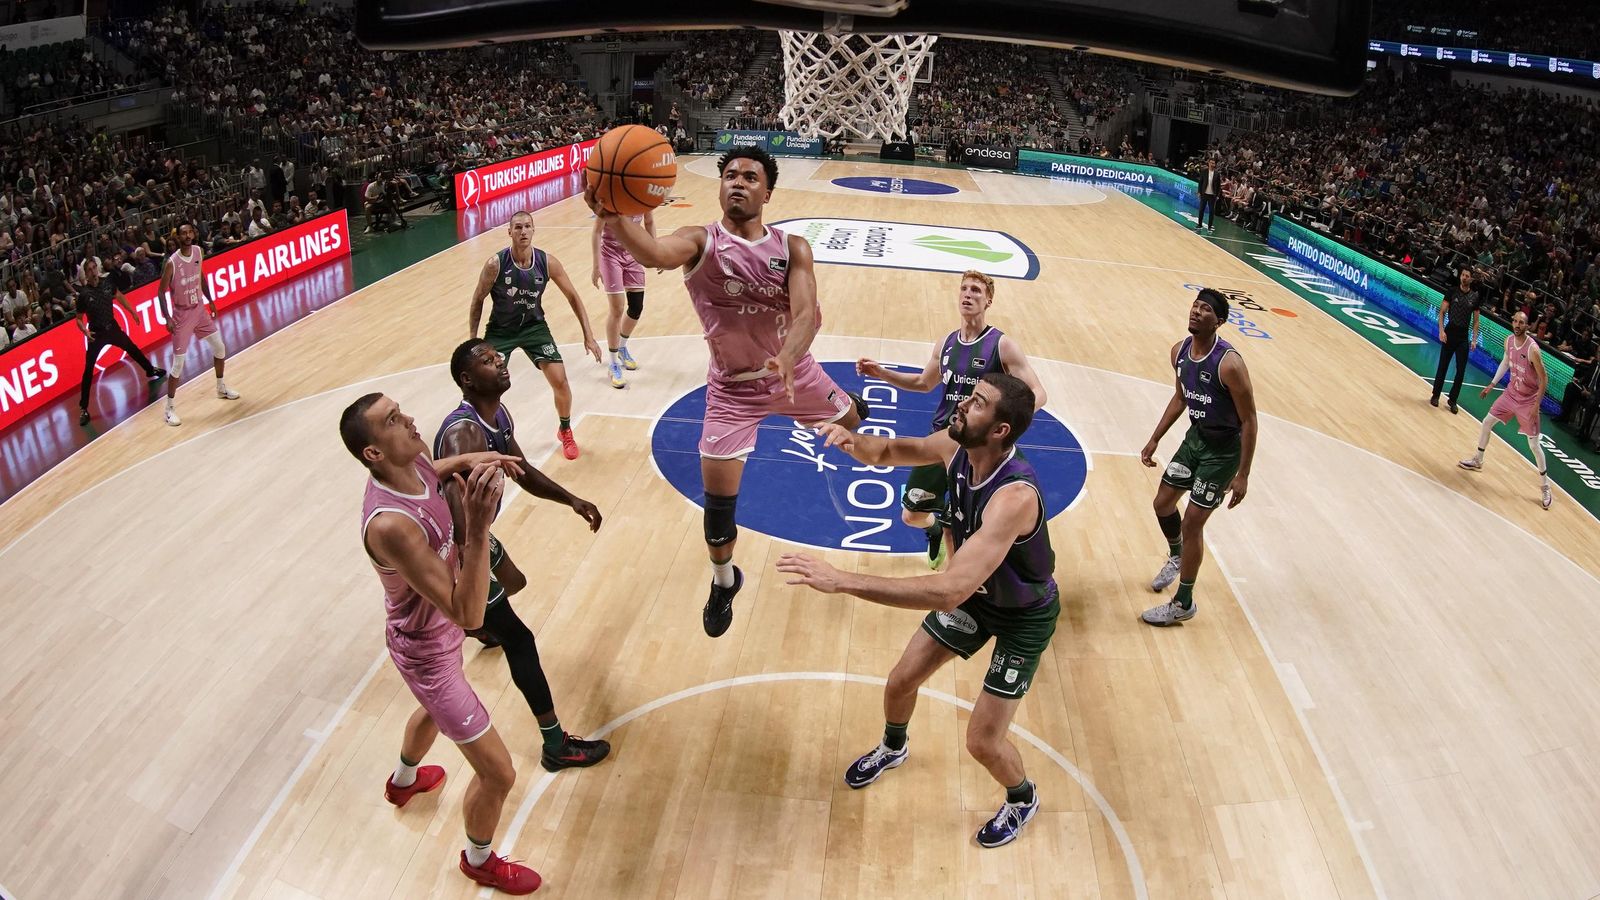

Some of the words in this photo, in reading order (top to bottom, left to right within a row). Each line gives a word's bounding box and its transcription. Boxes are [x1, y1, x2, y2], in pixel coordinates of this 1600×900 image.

[965, 147, 1011, 160] endesa
[483, 167, 527, 193] TURKISH
[527, 154, 564, 178] AIRLINES
[1051, 162, 1094, 176] PARTIDO
[1096, 168, 1145, 183] DEDICADO
[1146, 175, 1154, 184] A
[1288, 236, 1318, 263] PARTIDO
[1318, 249, 1360, 285] DEDICADO
[1360, 274, 1368, 290] A
[136, 260, 247, 333] TUISH
[253, 224, 341, 283] AIRLINES
[1184, 389, 1212, 405] Unicaja
